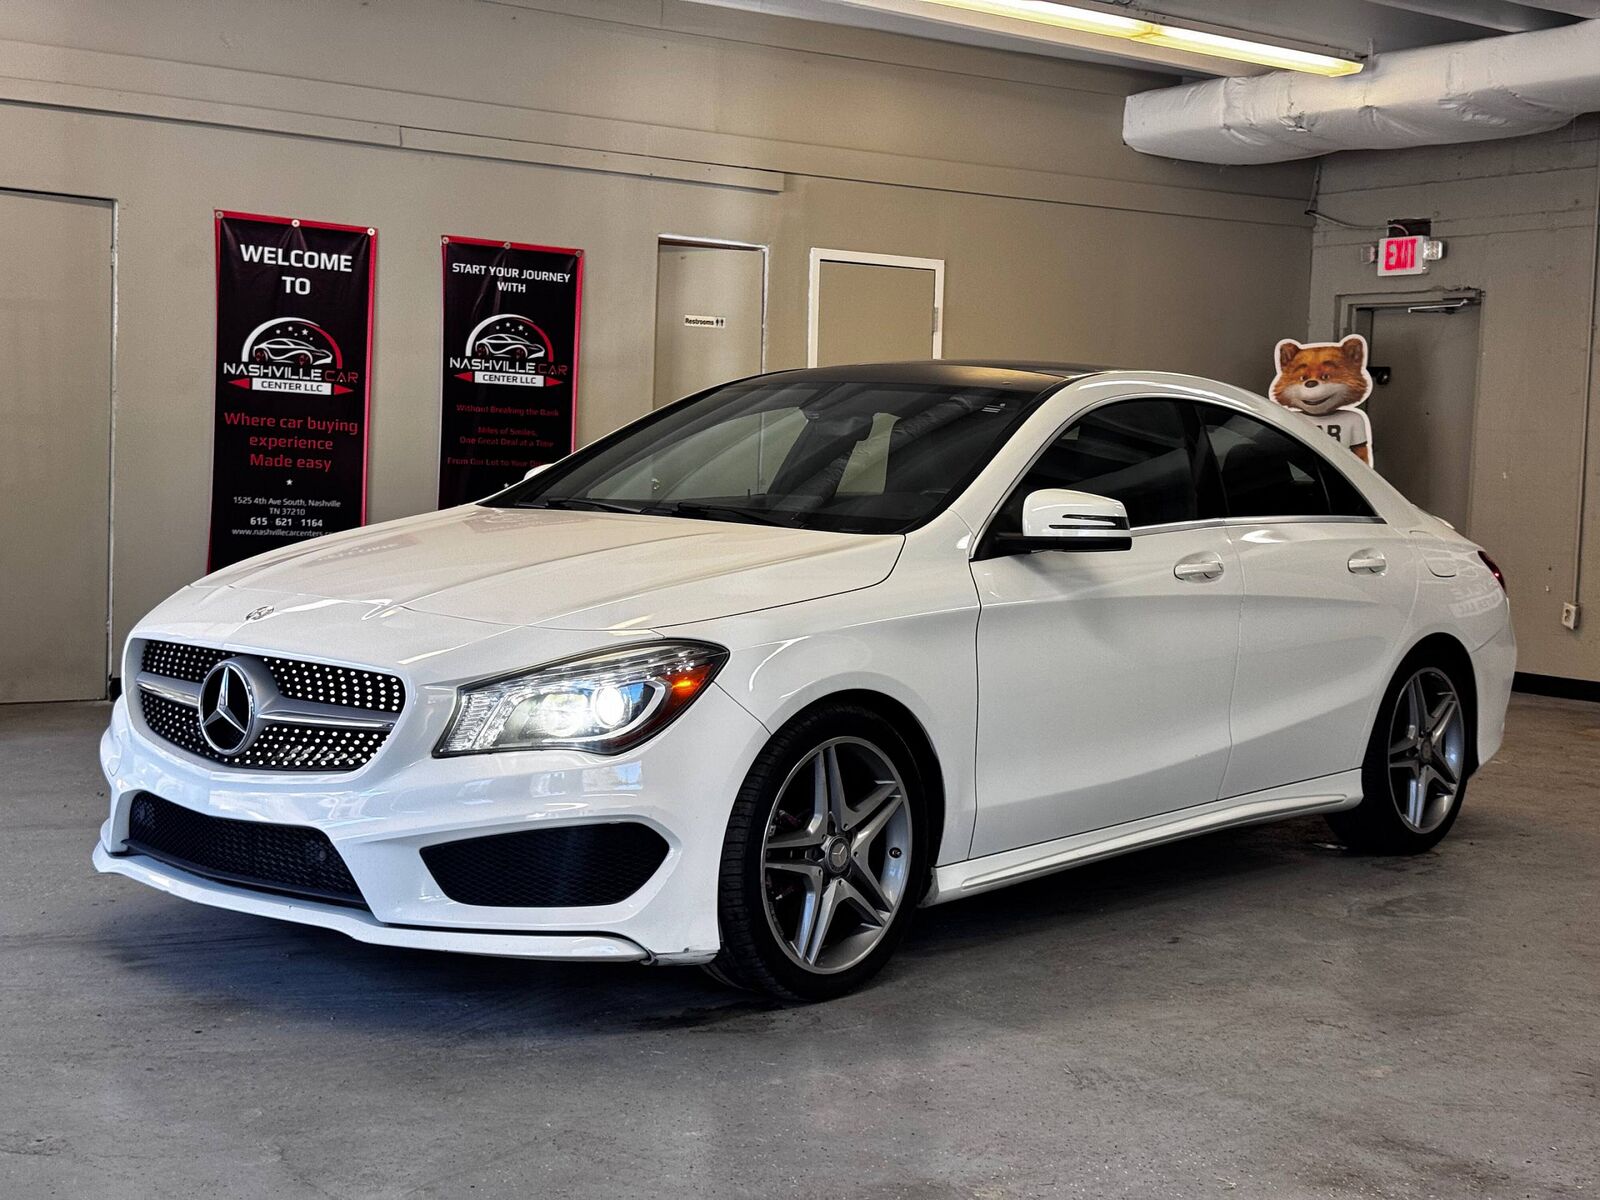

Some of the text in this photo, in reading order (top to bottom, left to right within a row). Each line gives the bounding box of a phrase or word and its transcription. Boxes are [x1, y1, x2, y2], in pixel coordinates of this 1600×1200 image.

[240, 244, 353, 272] WELCOME
[1385, 238, 1417, 271] EXIT
[452, 262, 570, 283] START YOUR JOURNEY
[282, 276, 310, 295] TO
[497, 281, 526, 293] WITH
[685, 318, 714, 326] Restrooms
[223, 362, 358, 383] NASHVILLE CAR
[450, 357, 568, 376] NASHVILLE CAR
[482, 374, 536, 384] CENTER LLC
[261, 380, 323, 392] CENTER LLC
[540, 408, 558, 416] Bank
[224, 412, 358, 436] Where car buying
[250, 436, 334, 450] experience
[460, 436, 476, 444] One
[250, 454, 332, 472] Made easy
[233, 496, 252, 504] 1525
[254, 497, 267, 505] 4th
[308, 500, 342, 508] Nashville
[270, 507, 306, 516] TN 37210
[250, 516, 323, 527] 615 621 1164
